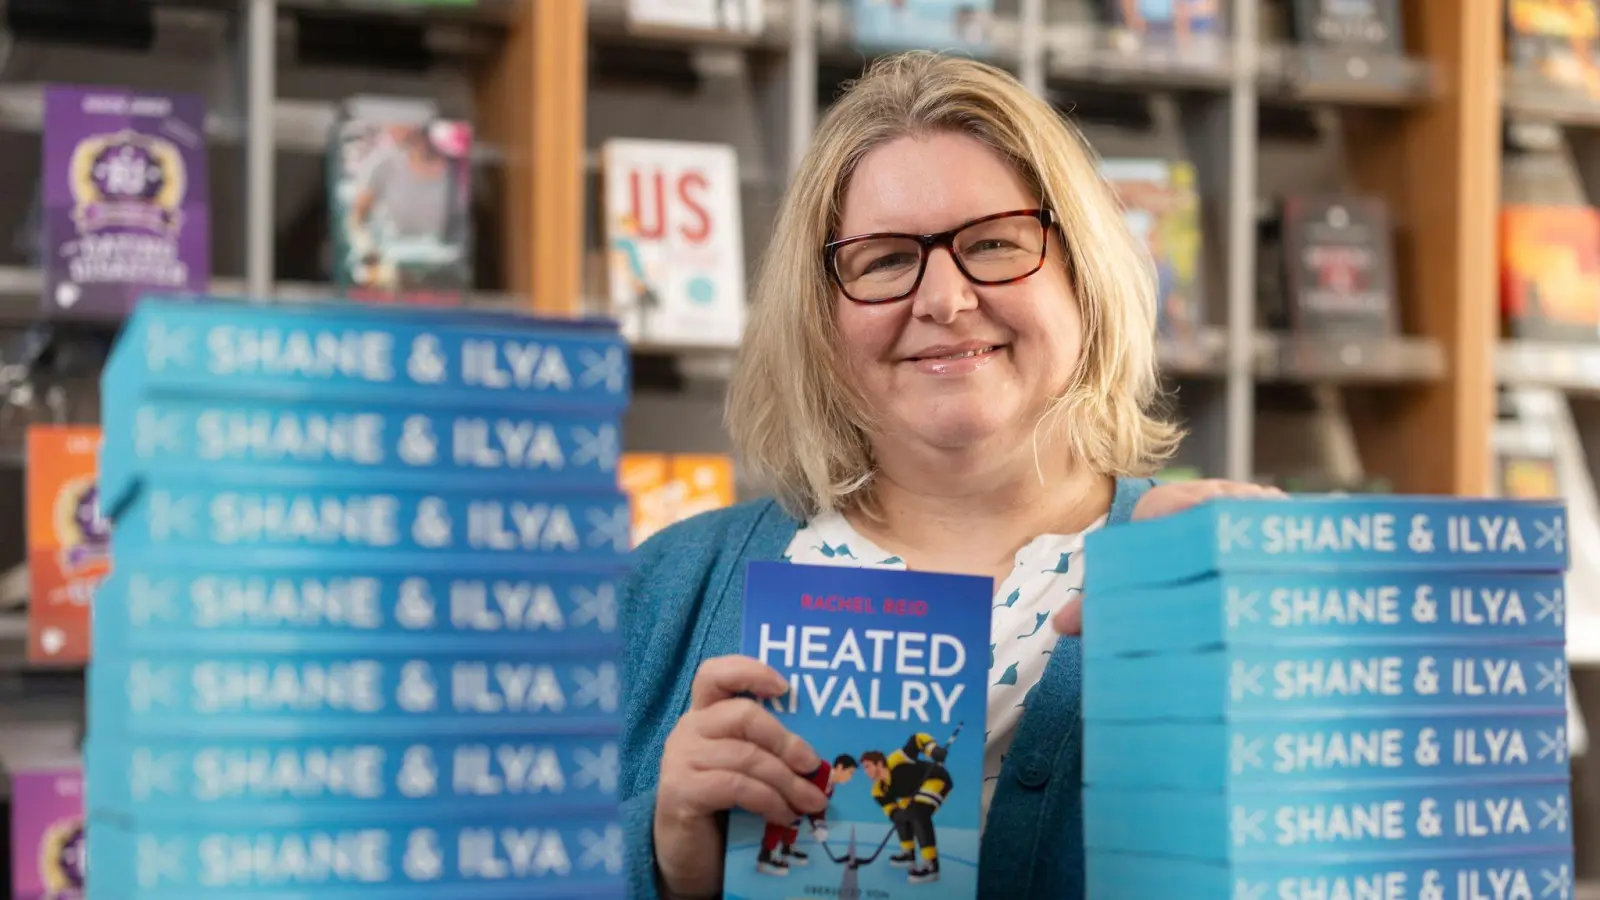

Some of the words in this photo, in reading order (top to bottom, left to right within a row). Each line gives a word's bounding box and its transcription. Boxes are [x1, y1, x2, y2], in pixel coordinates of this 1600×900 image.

[628, 168, 712, 244] US
[206, 325, 394, 381] SHANE
[407, 334, 446, 385] &
[461, 340, 571, 390] ILYA
[198, 407, 384, 465] SHANE
[398, 414, 438, 466] &
[452, 416, 565, 469] ILYA
[209, 491, 399, 546] SHANE
[413, 496, 452, 548] &
[467, 500, 579, 550] ILYA
[1262, 514, 1396, 553] SHANE
[1408, 514, 1435, 553] &
[1448, 516, 1526, 552] ILYA
[191, 574, 383, 629] SHANE
[396, 577, 436, 629] &
[450, 578, 564, 630] ILYA
[801, 594, 876, 613] RACHEL
[883, 599, 929, 616] REID
[1269, 586, 1400, 627] SHANE
[1411, 585, 1437, 623] &
[1451, 587, 1525, 625] ILYA
[758, 623, 966, 677] HEATED
[192, 659, 383, 712] SHANE
[398, 660, 437, 711] &
[451, 661, 566, 712] ILYA
[1273, 657, 1402, 700] SHANE
[1414, 656, 1440, 695] &
[1452, 659, 1527, 695] ILYA
[193, 745, 386, 798] SHANE
[398, 745, 438, 797] &
[452, 744, 565, 796] ILYA
[1273, 729, 1404, 772] SHANE
[1415, 728, 1440, 766] &
[1454, 729, 1528, 764] ILYA
[1275, 801, 1406, 845] SHANE
[1416, 798, 1441, 837] &
[1454, 798, 1530, 837] ILYA
[199, 828, 390, 886] SHANE
[403, 827, 442, 880] &
[458, 827, 570, 879] ILYA
[1276, 871, 1408, 900] SHANE
[1418, 869, 1444, 900] &
[1456, 868, 1532, 900] ILYA
